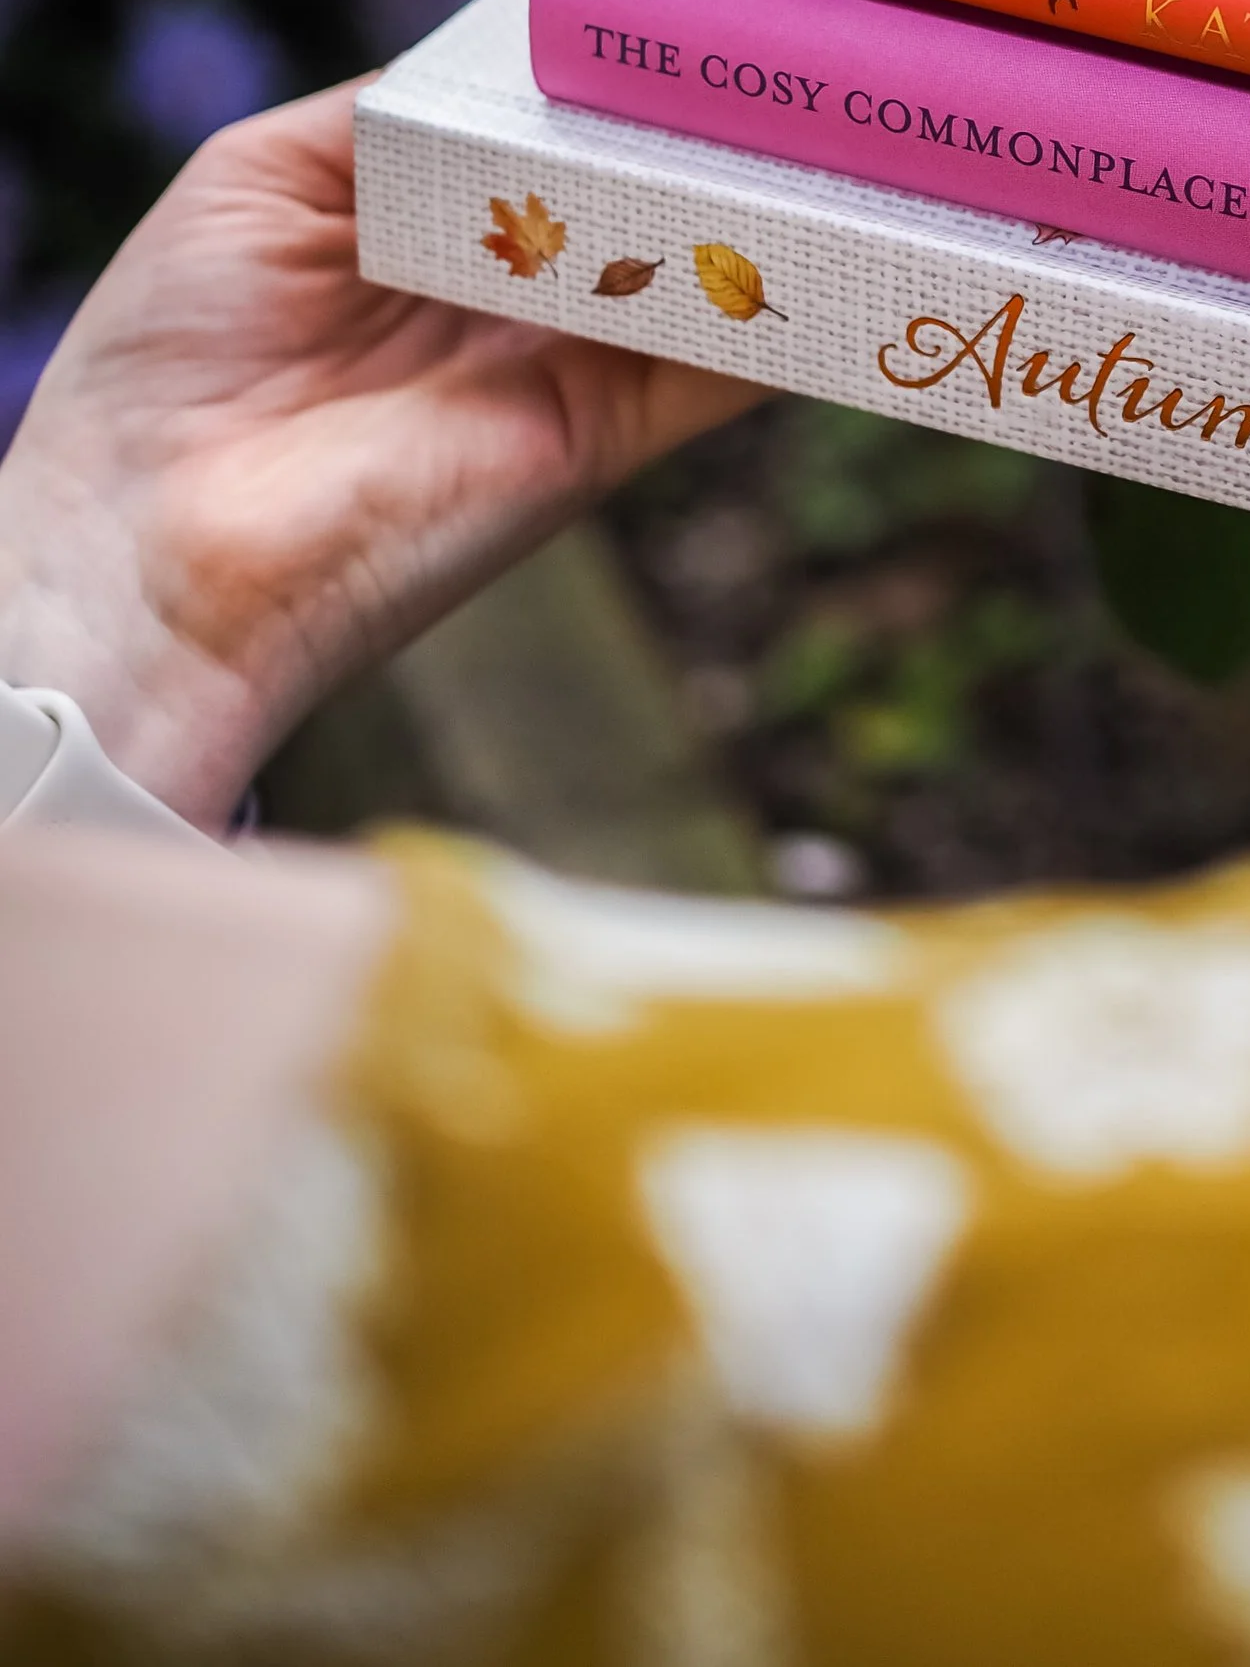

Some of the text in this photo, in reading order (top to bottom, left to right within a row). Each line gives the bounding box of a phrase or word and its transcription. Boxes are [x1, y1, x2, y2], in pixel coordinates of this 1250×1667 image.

[583, 24, 682, 78] THE
[700, 54, 829, 113] COSY
[844, 90, 1248, 220] COMMONPLACE
